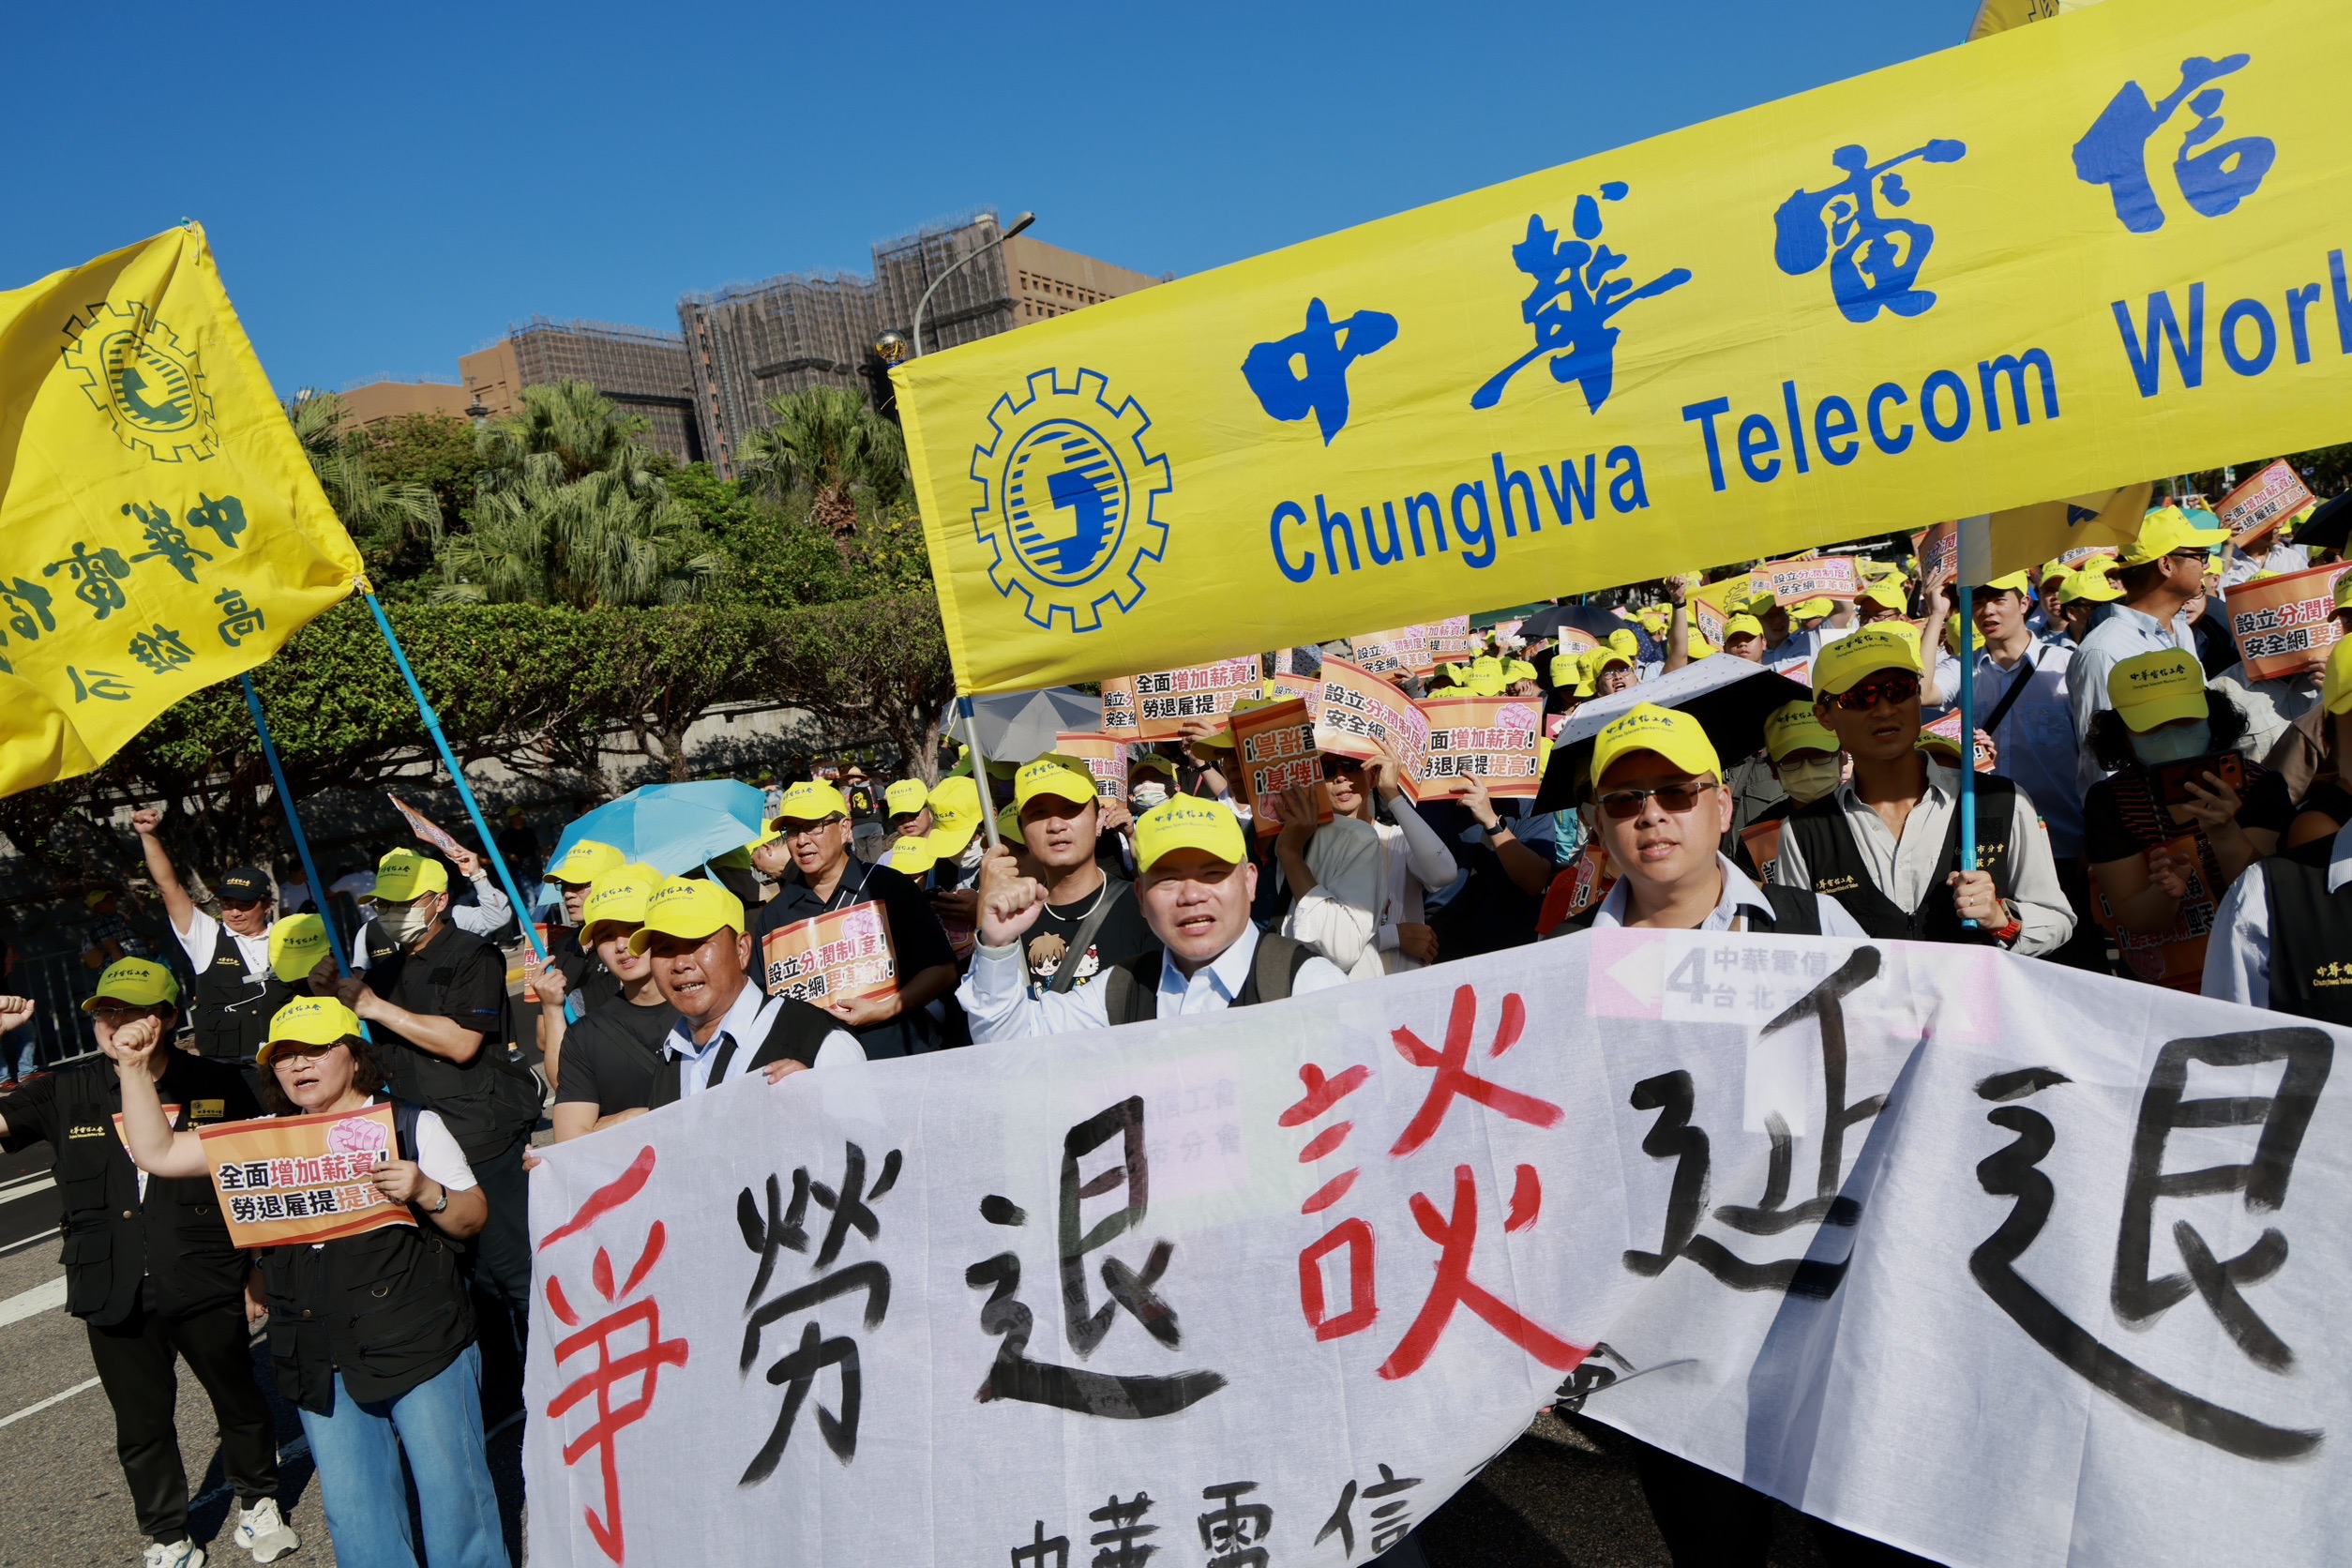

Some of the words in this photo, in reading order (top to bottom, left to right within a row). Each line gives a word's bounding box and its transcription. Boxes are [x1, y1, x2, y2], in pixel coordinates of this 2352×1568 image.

[1241, 53, 2277, 447] 中華電信
[1271, 444, 1650, 583] Chunghwa
[1682, 346, 2060, 492] Telecom
[2238, 486, 2307, 534] 退雇提提高!
[1425, 626, 1466, 638] 加薪資!
[1136, 664, 1257, 695] 全面增加薪資!
[1142, 688, 1262, 720] 勞退雇提提高!
[1323, 682, 1427, 759] 設立分潤制度!
[767, 933, 887, 986] 設立分潤制度!
[1666, 947, 1711, 1004] 4
[219, 1151, 389, 1190] 全面增加薪資!
[230, 1183, 393, 1222] 勞退雇提提高
